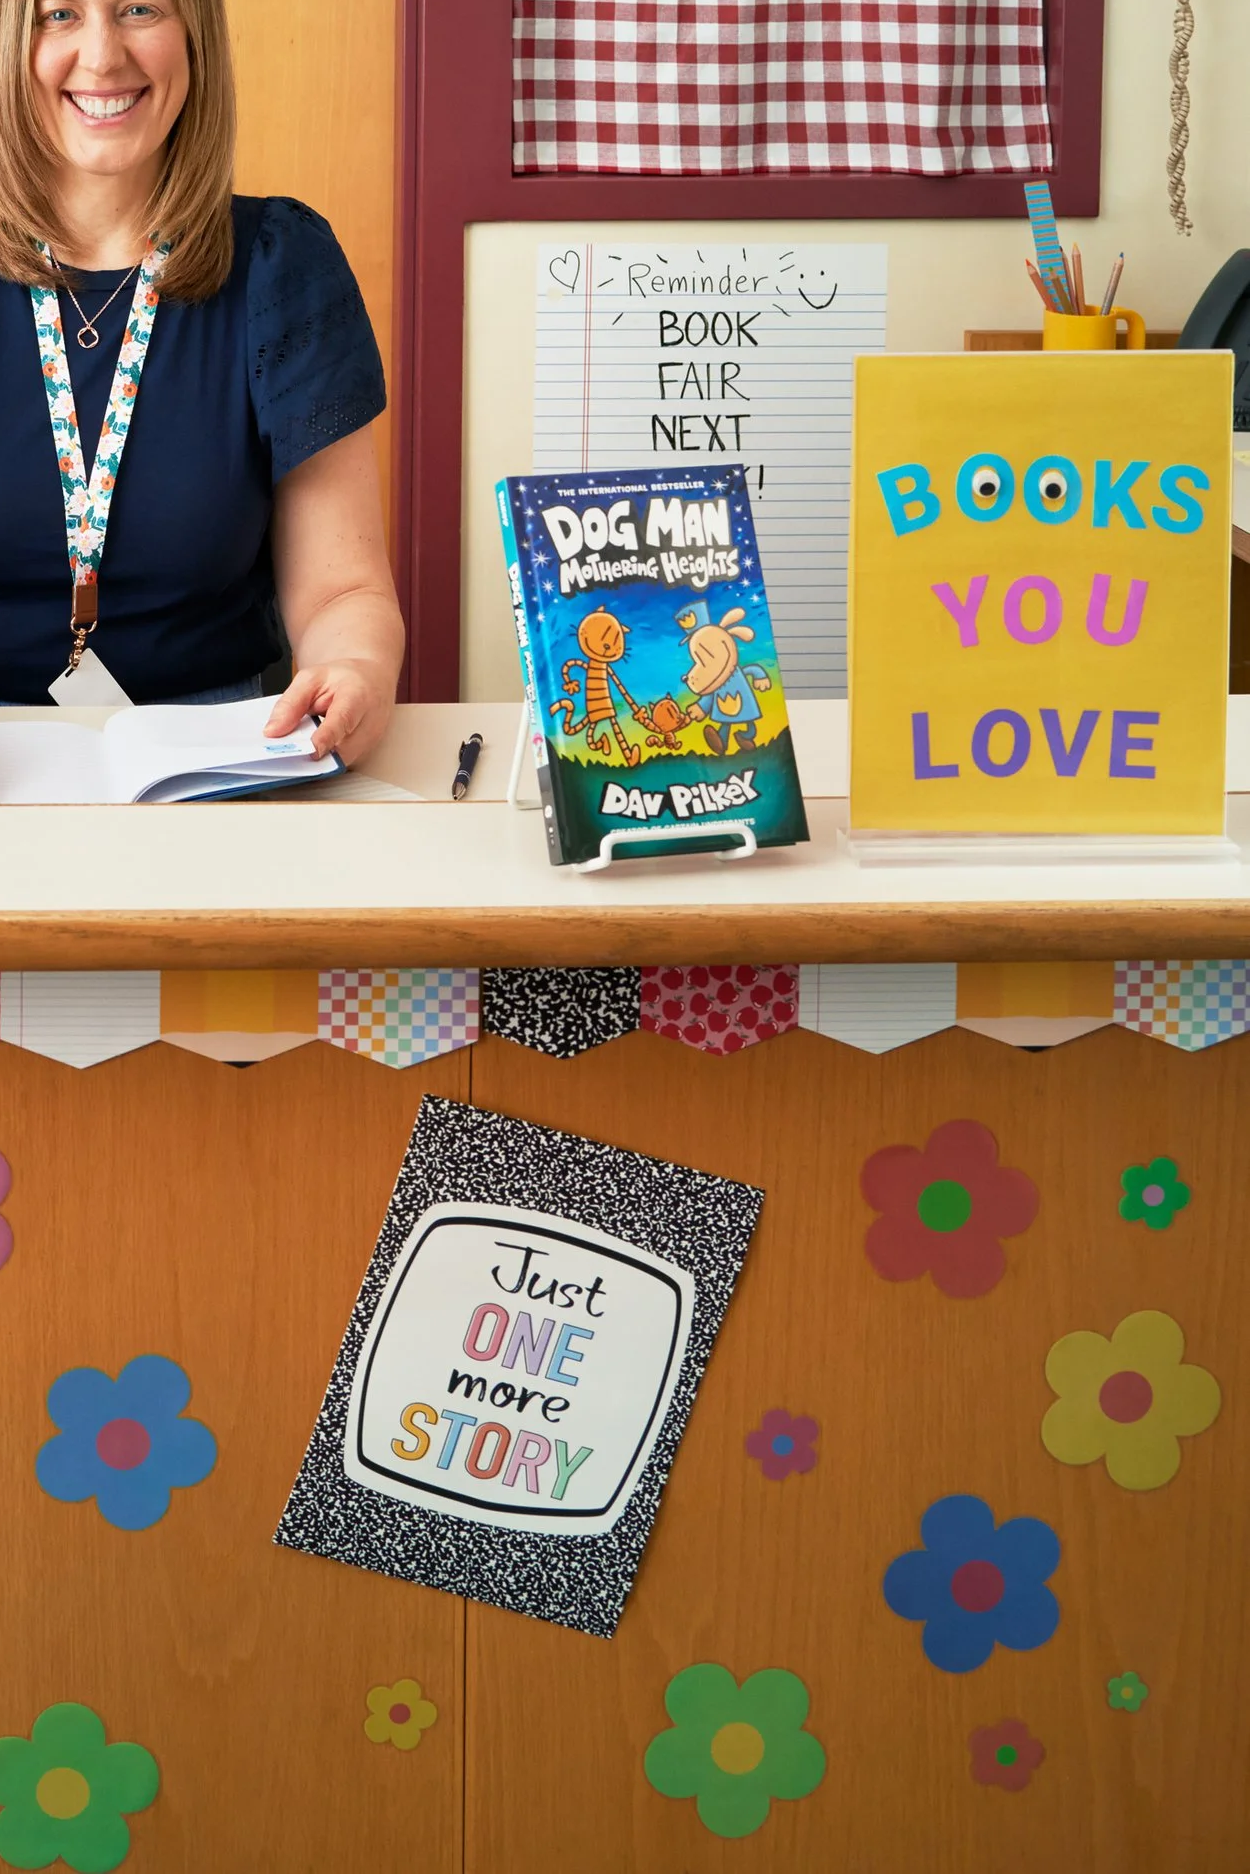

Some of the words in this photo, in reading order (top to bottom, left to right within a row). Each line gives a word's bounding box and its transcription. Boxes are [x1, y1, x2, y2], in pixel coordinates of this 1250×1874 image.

[627, 262, 769, 298] Reminder
[658, 309, 762, 348] BOOK
[657, 361, 751, 402] FAIR
[650, 413, 751, 452] NEXT
[557, 488, 576, 497] THE
[578, 484, 648, 496] INTERNATIONAL
[650, 480, 705, 492] BESTSELLER
[876, 452, 1211, 538] BOOKS
[541, 499, 639, 562] DOG
[645, 497, 731, 548] MAN
[930, 572, 1149, 648] YOU
[911, 707, 1161, 781] LOVE
[601, 782, 664, 820] DAV
[491, 1240, 607, 1318] Just
[462, 1302, 595, 1387] ONE
[447, 1367, 571, 1424] more
[390, 1401, 594, 1502] STORY
